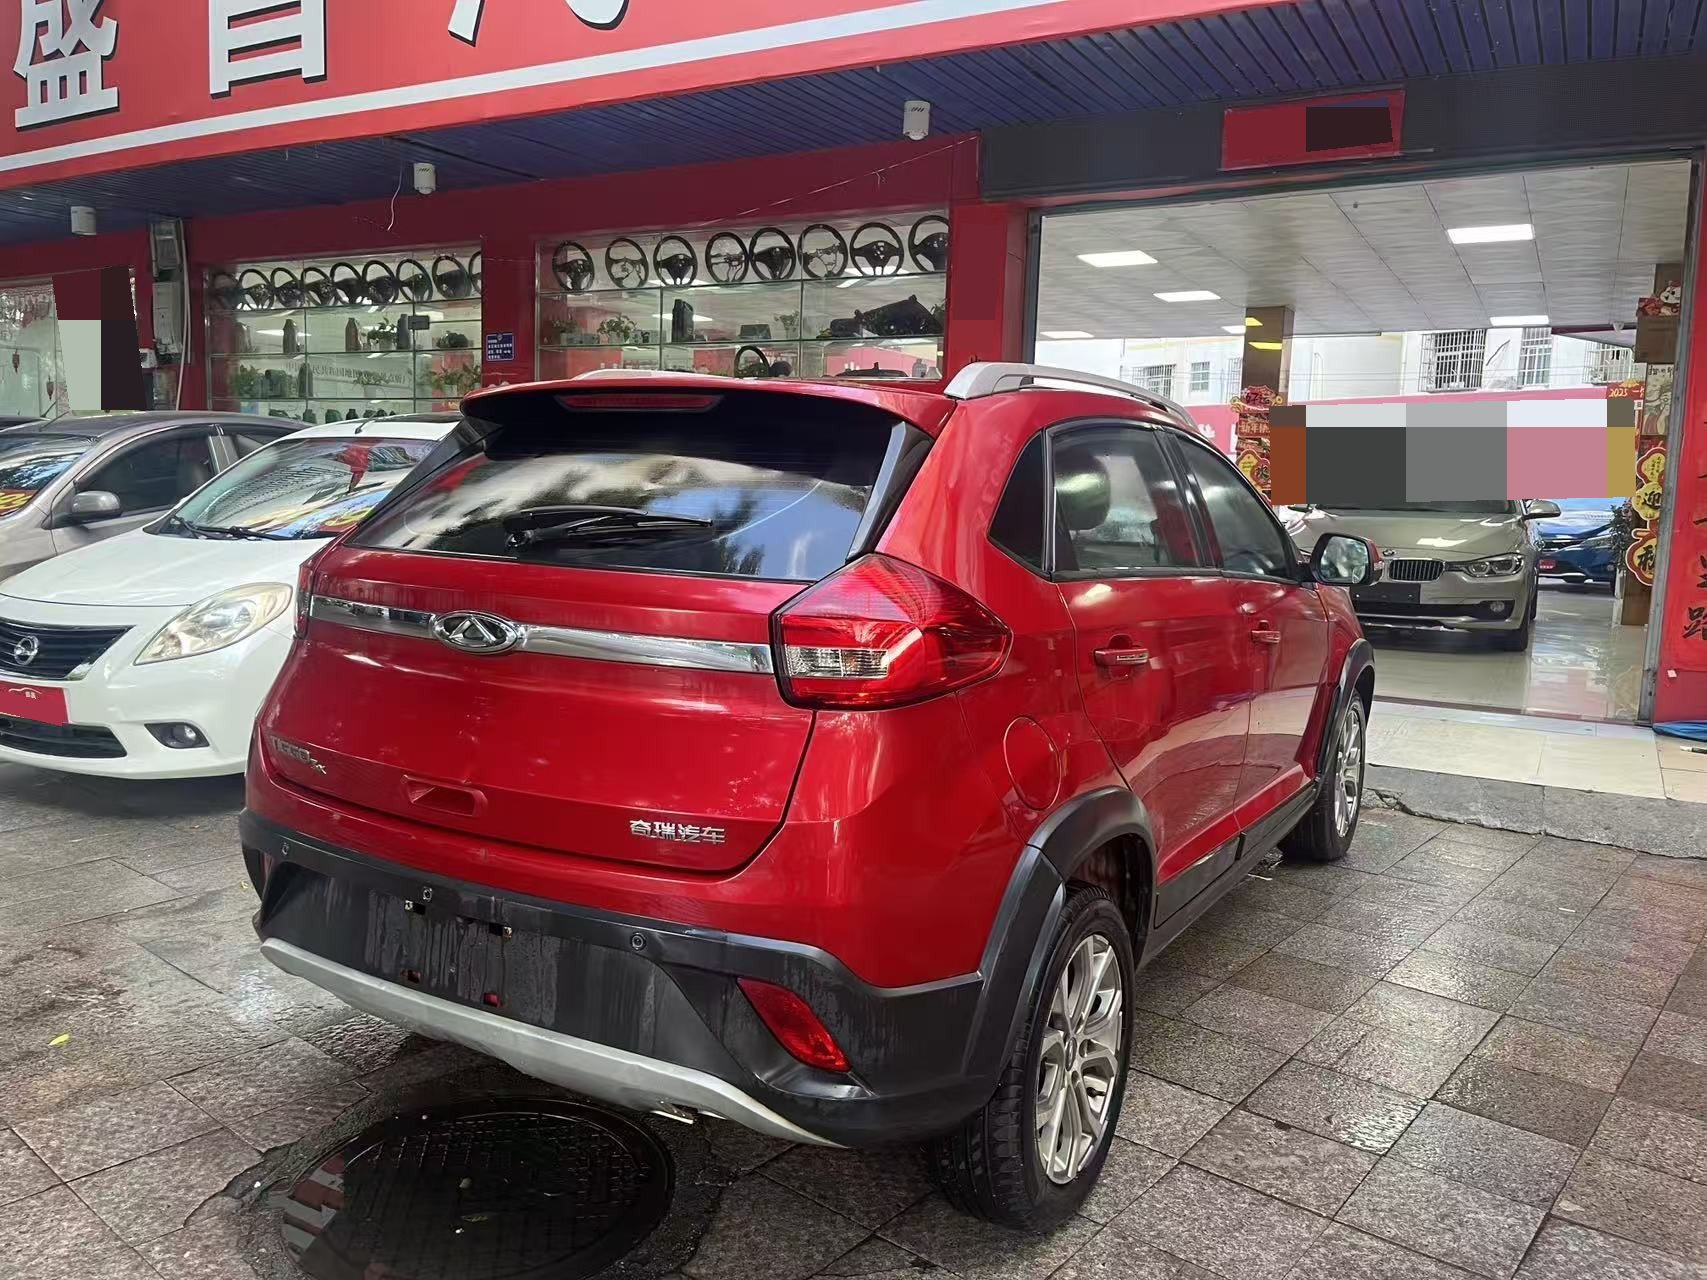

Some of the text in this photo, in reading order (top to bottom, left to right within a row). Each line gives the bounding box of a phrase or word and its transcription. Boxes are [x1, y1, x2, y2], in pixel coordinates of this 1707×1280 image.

[1608, 387, 1628, 398] 2025
[629, 819, 725, 844] 奇瑞汽车
